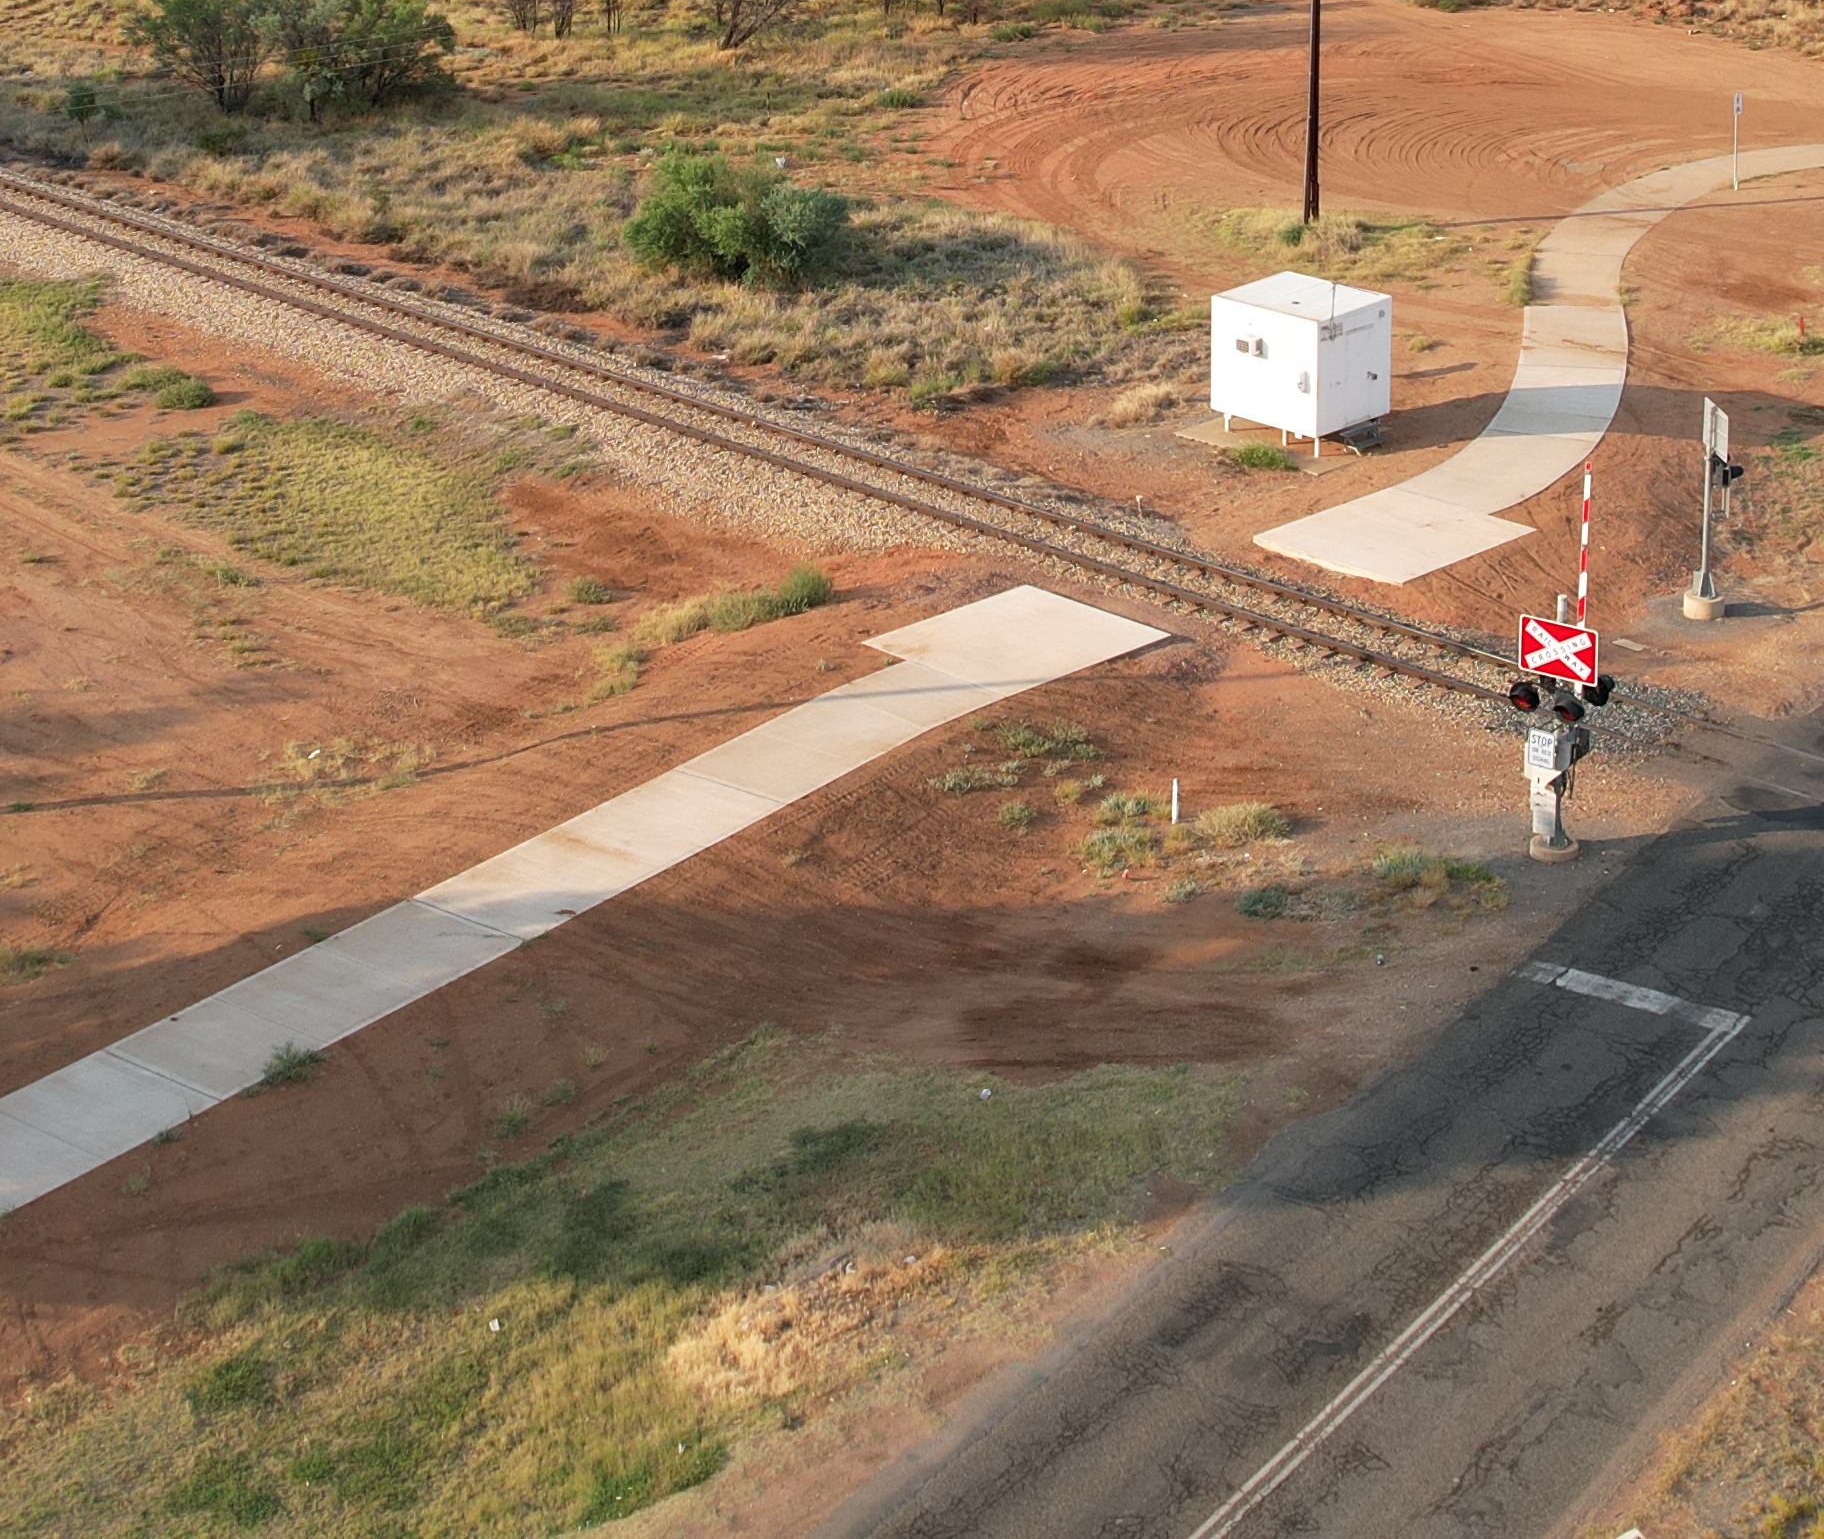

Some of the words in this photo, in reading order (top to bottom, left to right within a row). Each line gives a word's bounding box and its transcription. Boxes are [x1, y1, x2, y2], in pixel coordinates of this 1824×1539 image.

[1531, 626, 1552, 648] RAIL
[1564, 654, 1586, 673] WAY
[1531, 638, 1586, 664] CROSSING
[1531, 734, 1553, 748] STOP
